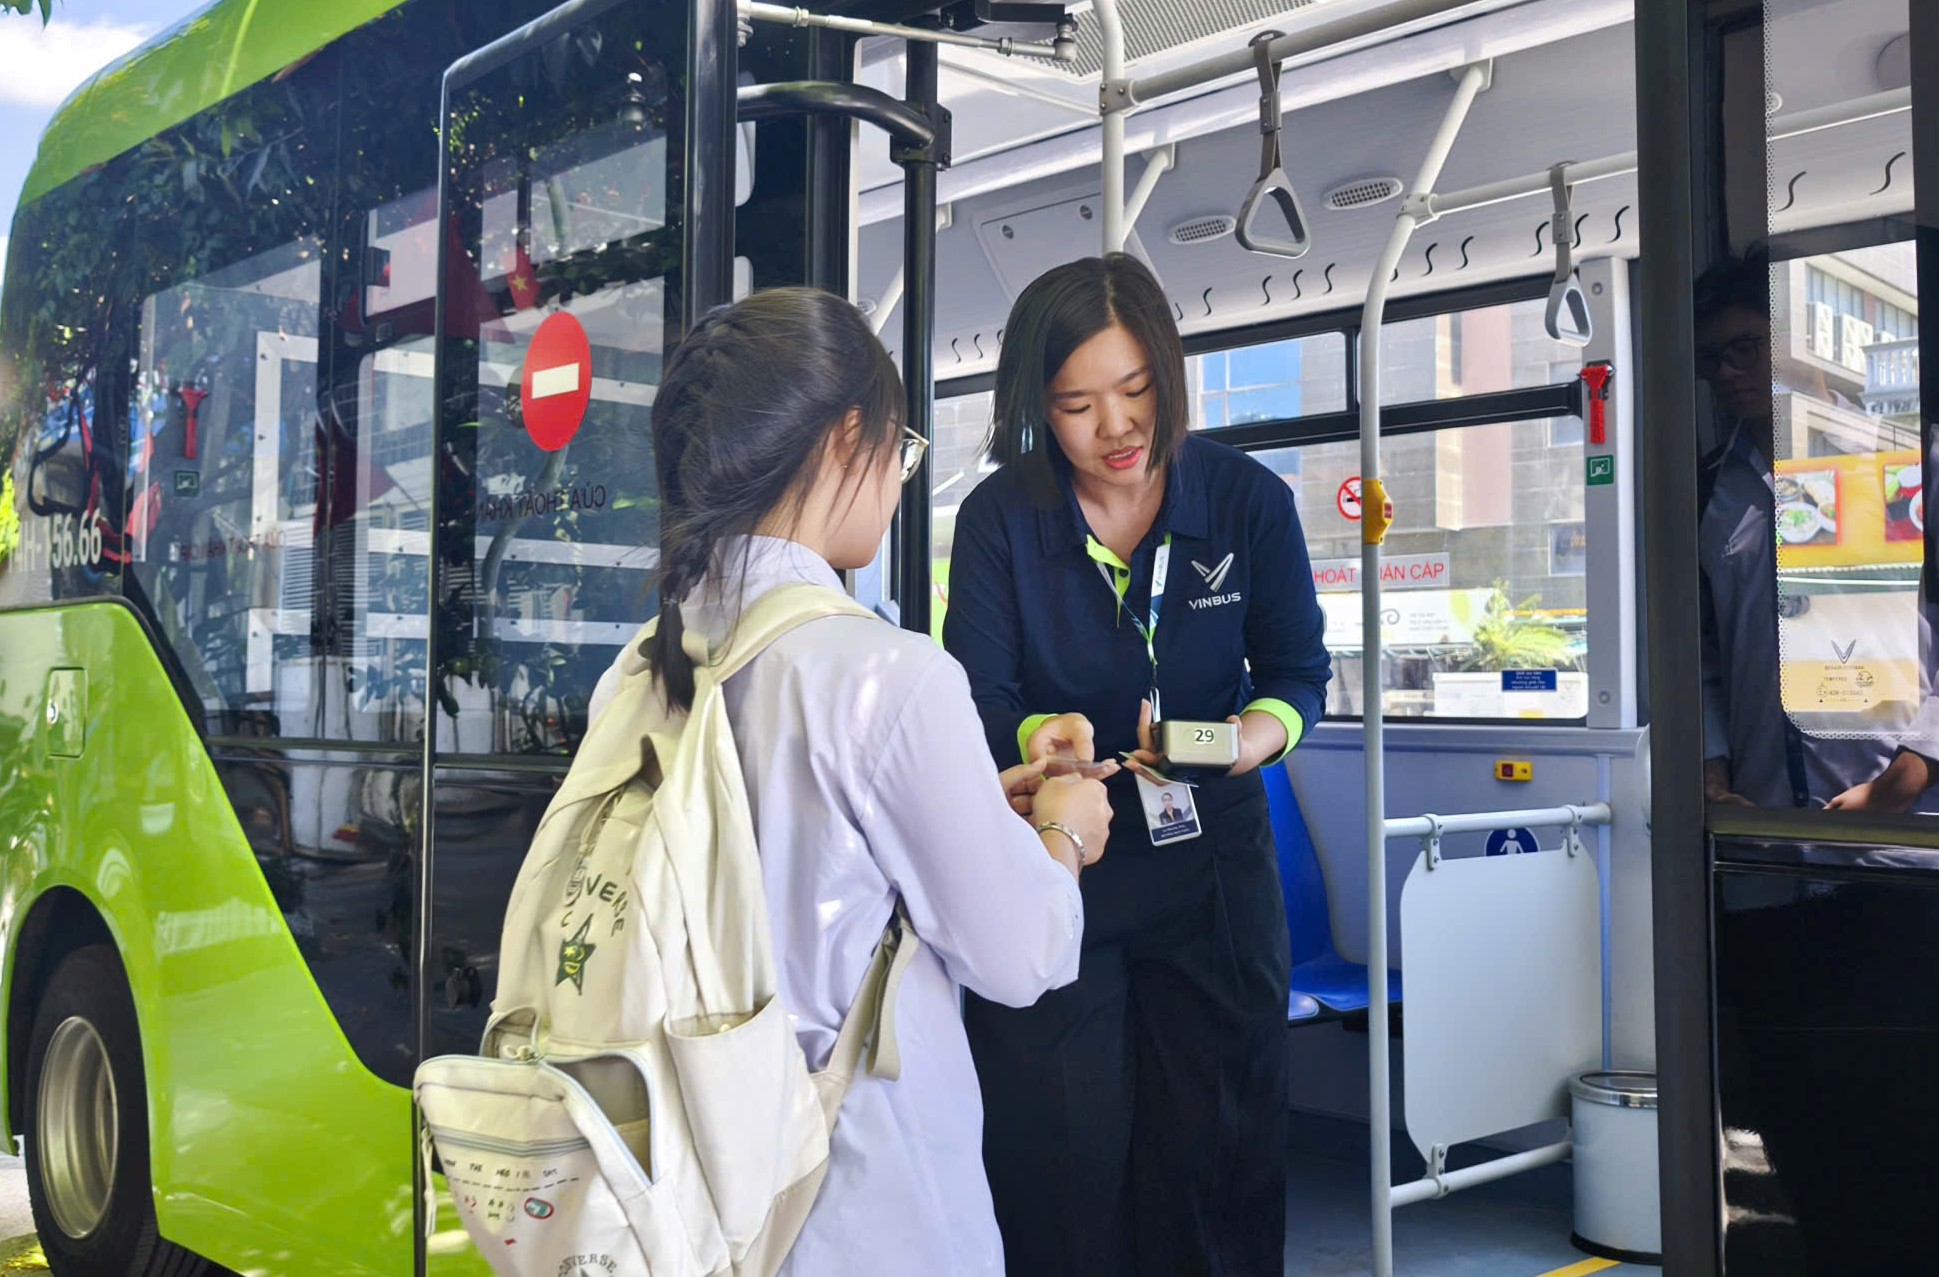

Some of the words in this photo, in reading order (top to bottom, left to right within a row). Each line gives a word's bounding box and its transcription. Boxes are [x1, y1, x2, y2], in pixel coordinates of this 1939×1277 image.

[1313, 565, 1357, 584] HOÁT
[1188, 592, 1241, 610] VINBUS
[1194, 729, 1215, 743] 29
